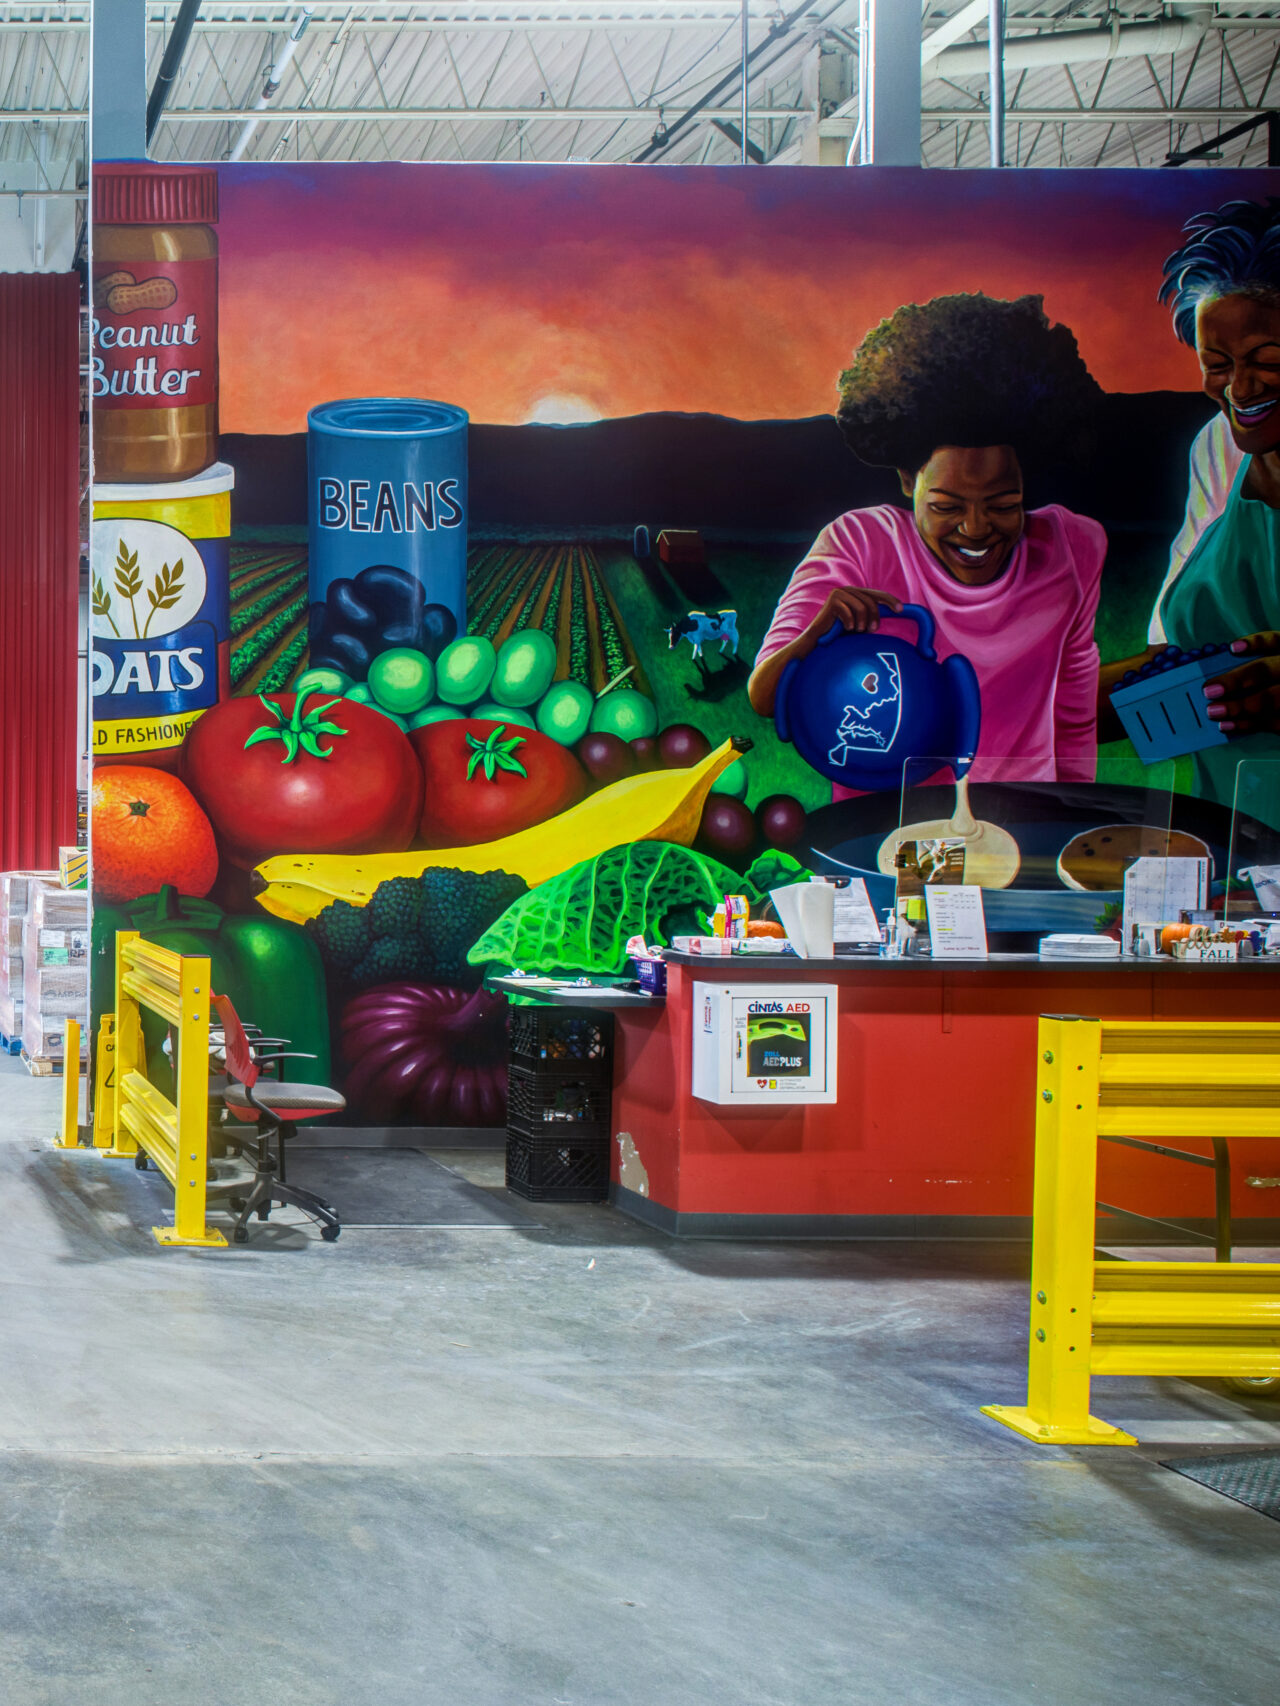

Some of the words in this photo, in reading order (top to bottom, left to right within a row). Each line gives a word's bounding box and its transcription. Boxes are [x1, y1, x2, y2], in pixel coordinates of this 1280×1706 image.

[92, 356, 201, 397] Butter
[318, 477, 464, 533] BEANS
[1200, 950, 1234, 959] FALL
[786, 1003, 810, 1012] AED
